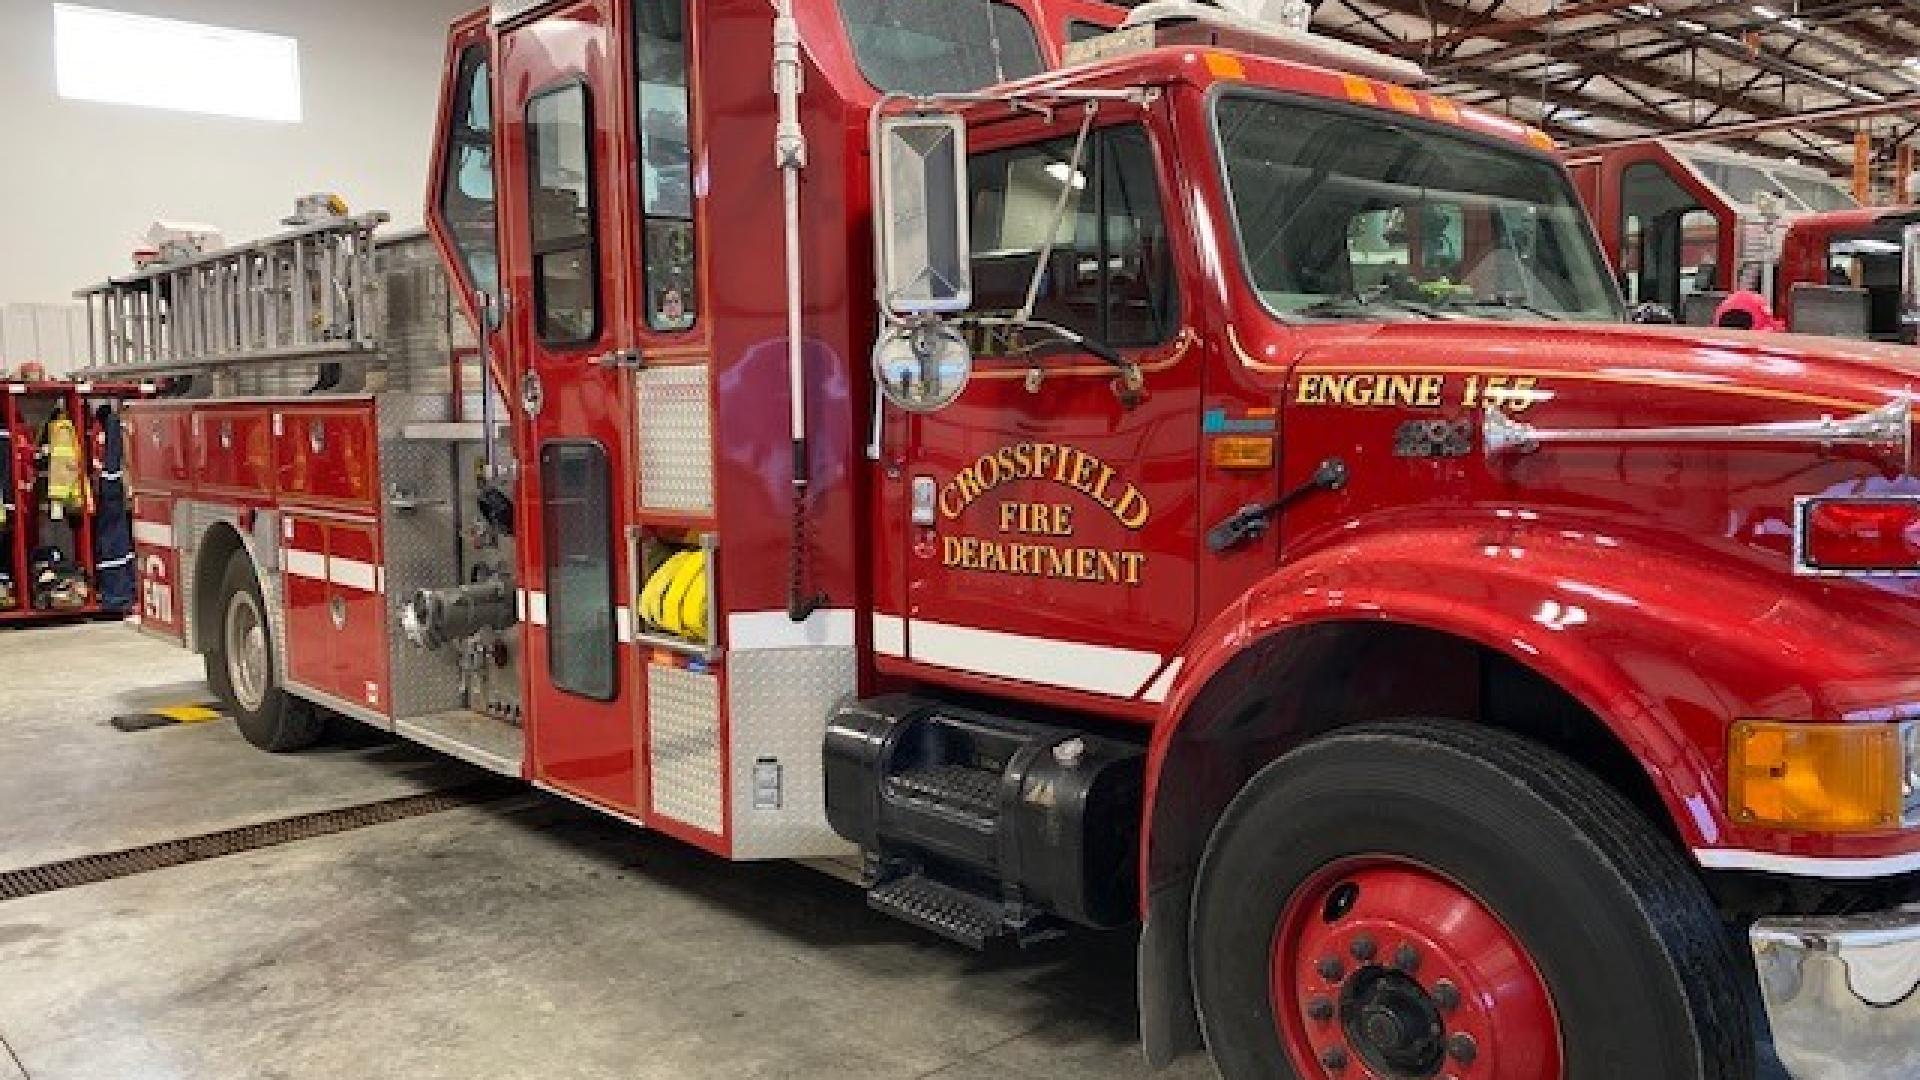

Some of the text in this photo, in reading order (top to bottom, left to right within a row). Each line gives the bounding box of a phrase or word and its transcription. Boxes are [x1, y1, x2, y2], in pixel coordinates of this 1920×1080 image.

[1295, 374, 1537, 412] ENGINE 155
[939, 442, 1150, 530] CROSSFIELD
[1000, 502, 1073, 536] FIRE
[942, 536, 1145, 584] DEPARTMENT
